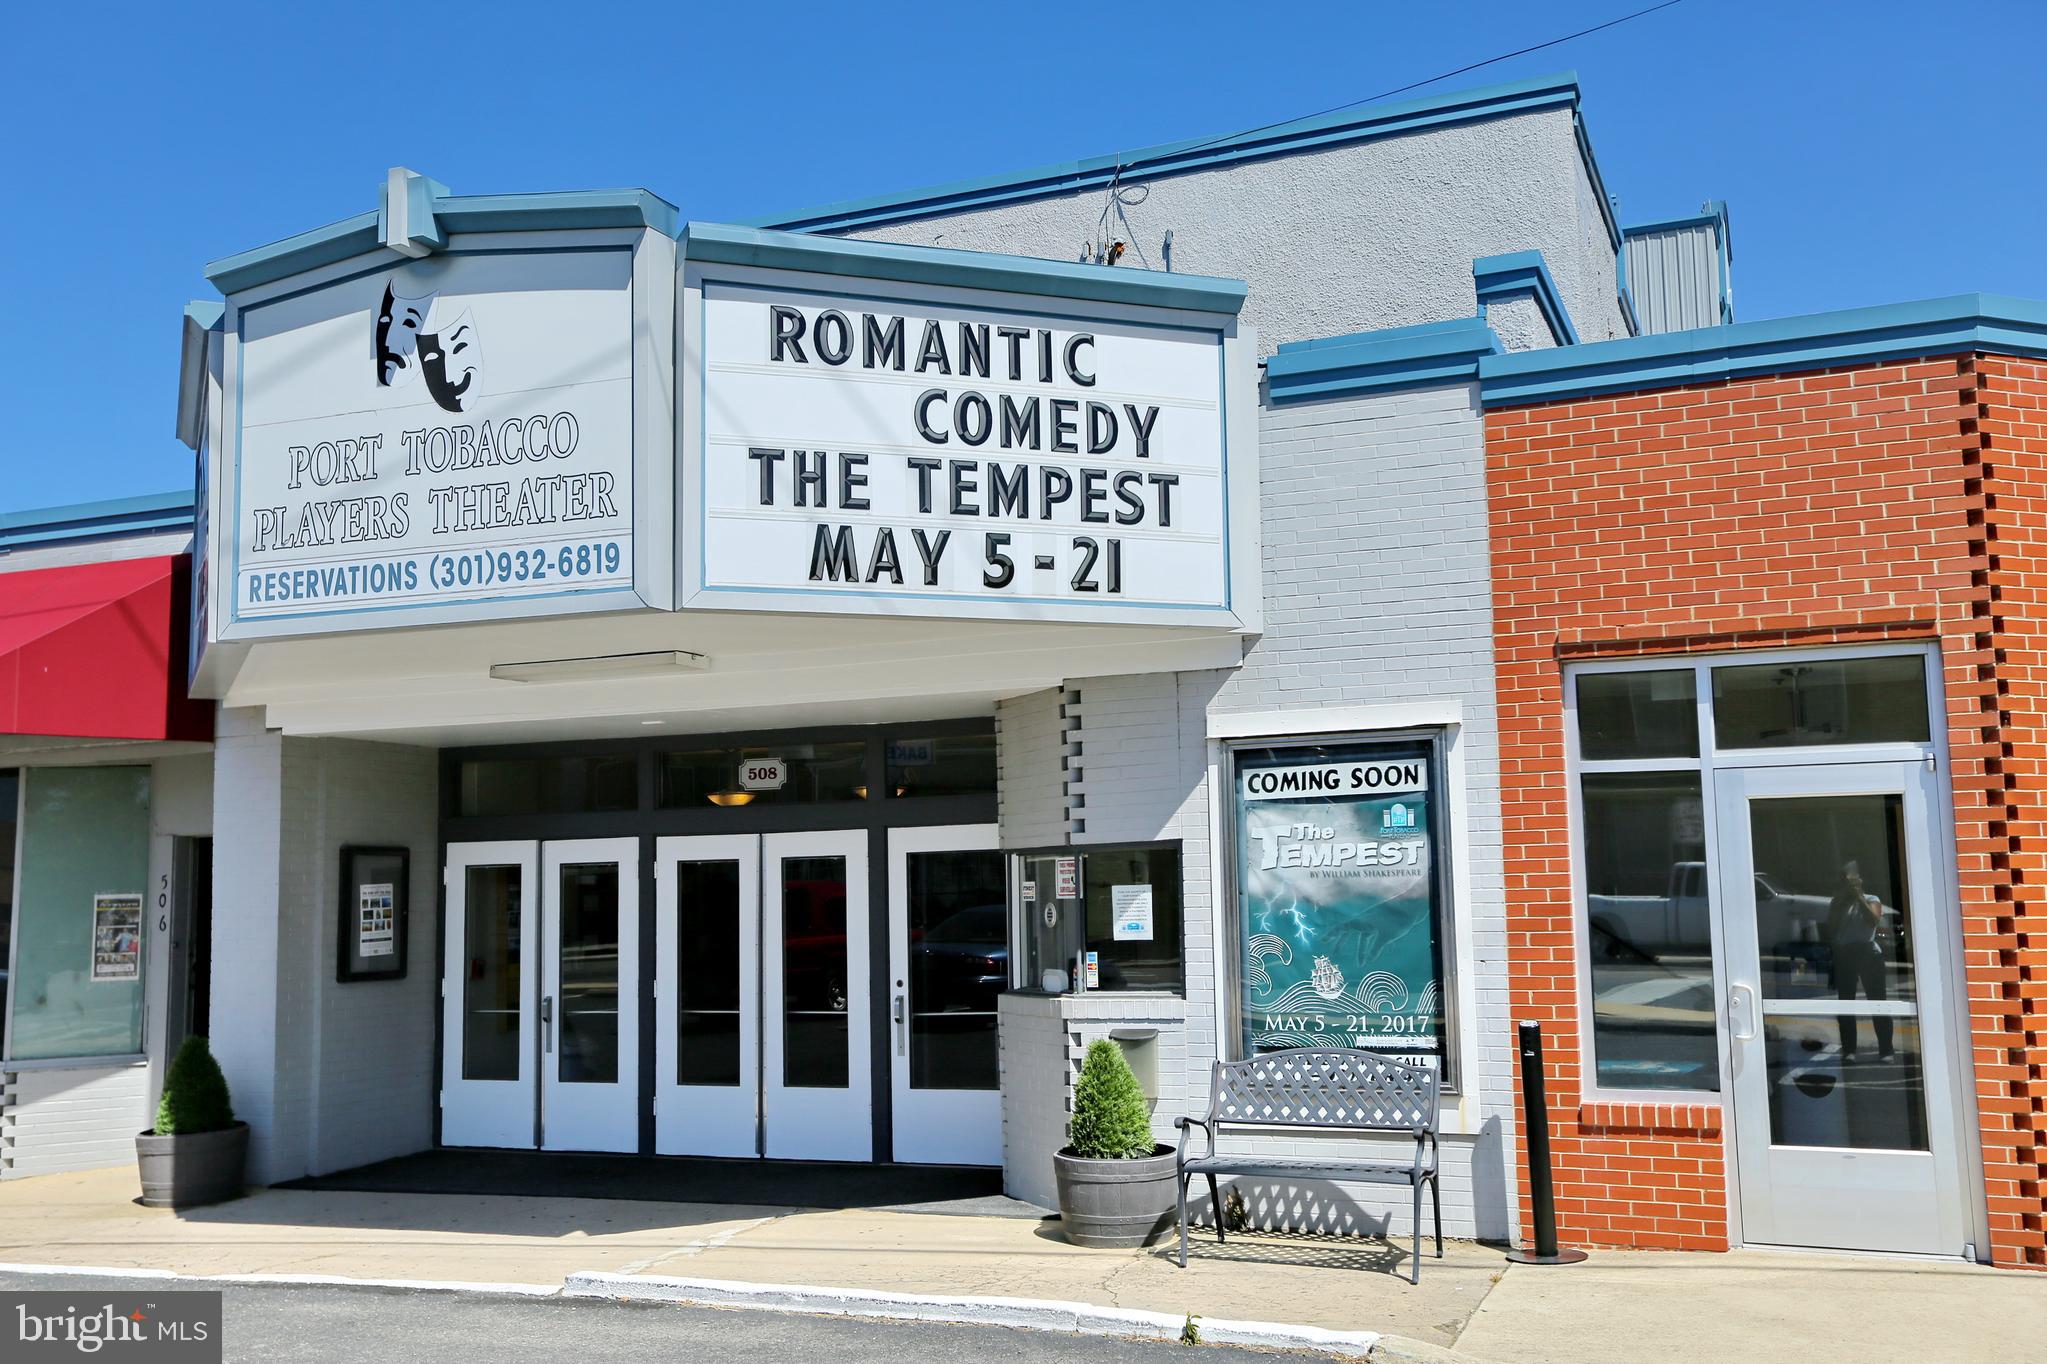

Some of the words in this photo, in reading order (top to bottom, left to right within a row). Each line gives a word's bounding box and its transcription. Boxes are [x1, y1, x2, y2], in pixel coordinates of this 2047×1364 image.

[770, 305, 1096, 386] ROMANTIC
[288, 433, 382, 489] PORT
[402, 412, 579, 477] TOBACCO
[914, 388, 1160, 458] COMEDY
[253, 493, 409, 552] PLAYERS
[429, 472, 617, 534] THEATER
[748, 447, 870, 510] THE
[907, 457, 1179, 527] TEMPEST
[249, 561, 417, 602] RESERVATIONS
[430, 542, 620, 589] (301)932-6819
[808, 524, 951, 586] MAY
[748, 767, 777, 781] 508
[1248, 769, 1340, 794] COMING
[1351, 765, 1418, 789] SOON
[1251, 825, 1424, 870] TEMPEST
[1293, 822, 1335, 840] The
[158, 874, 168, 931] 506
[1322, 870, 1361, 878] WILLIAM
[1363, 869, 1422, 878] SHAKESPEARE
[1264, 1014, 1309, 1031] MAY
[1315, 1015, 1325, 1031] 5
[1346, 1015, 1375, 1034] 21,
[1381, 1015, 1429, 1033] 2017
